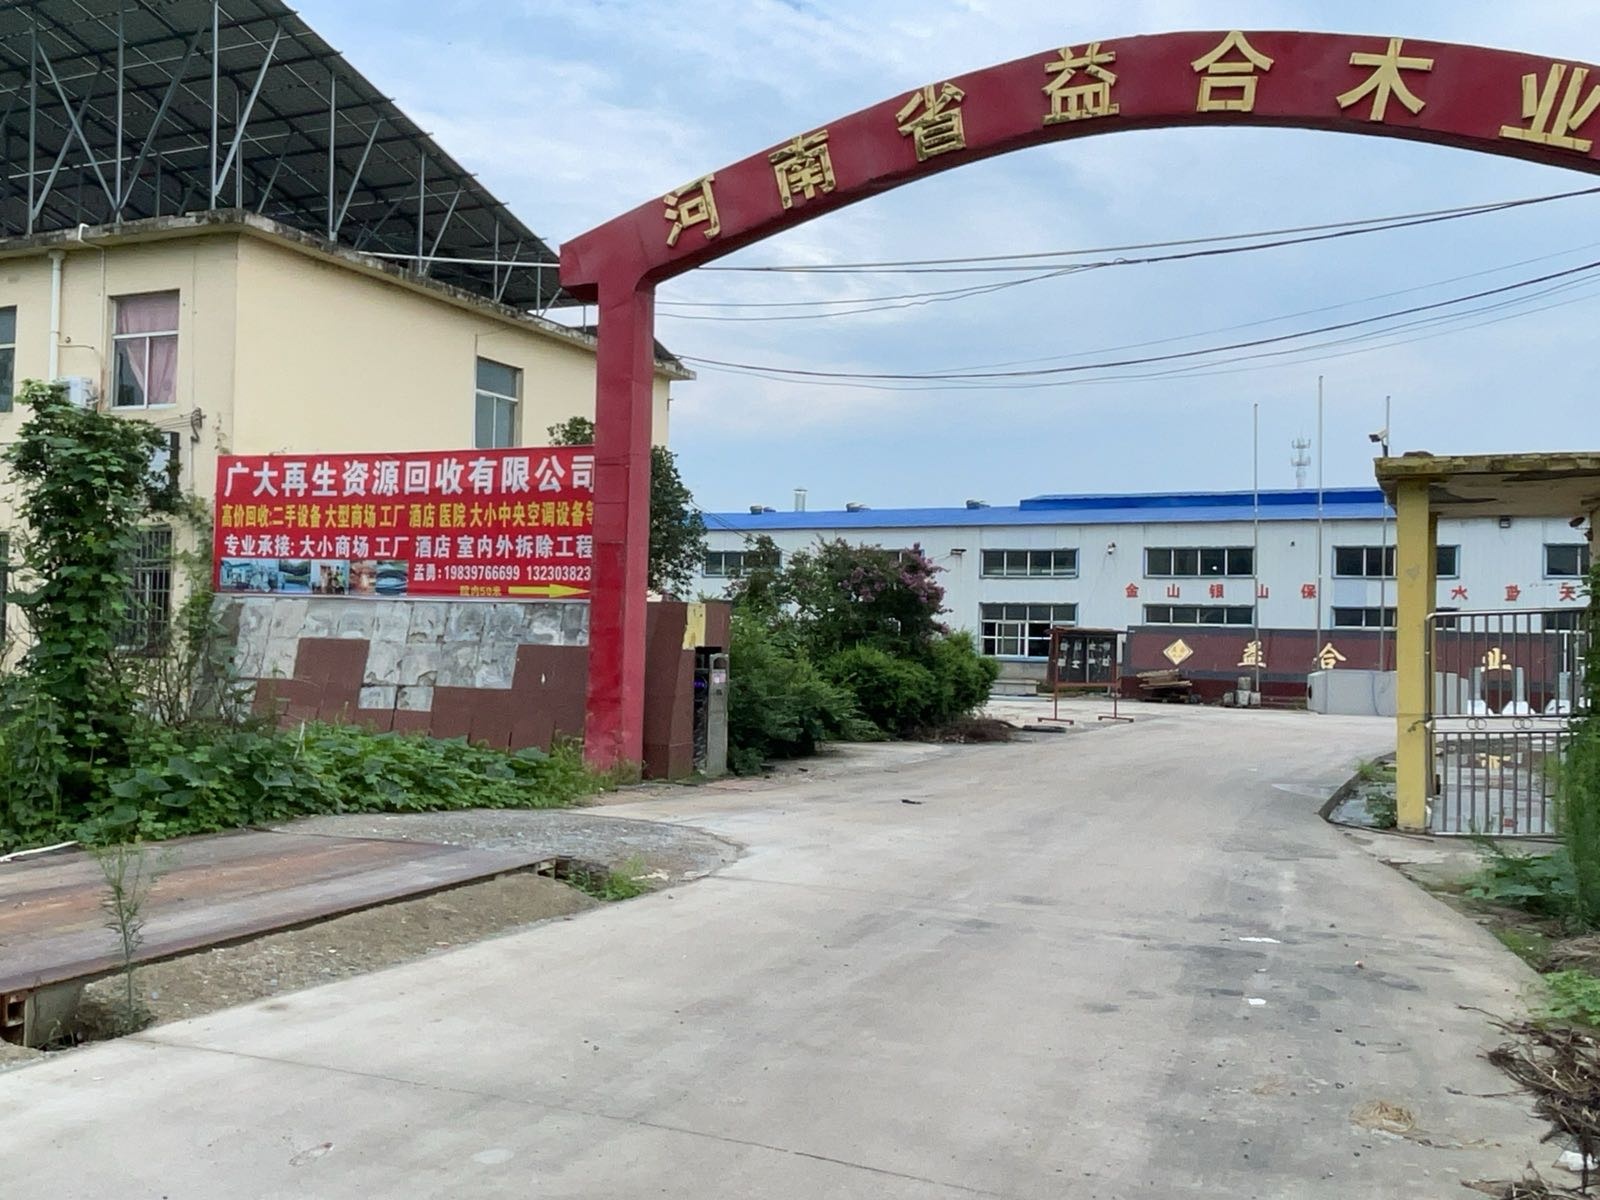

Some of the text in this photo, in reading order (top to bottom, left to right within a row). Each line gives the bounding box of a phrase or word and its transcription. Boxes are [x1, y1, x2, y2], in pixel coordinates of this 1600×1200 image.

[663, 31, 1600, 247] 河南省益合木业
[223, 455, 595, 497] 广大再生资源回收有限公司
[325, 504, 376, 528] 大型商场
[379, 504, 406, 528] 工厂
[409, 503, 436, 528] 酒店
[439, 502, 467, 528] 医院
[299, 534, 369, 558] 大小商场
[374, 536, 409, 558] 工厂
[415, 535, 451, 559] 酒店
[456, 534, 593, 559] 室内外拆除工程
